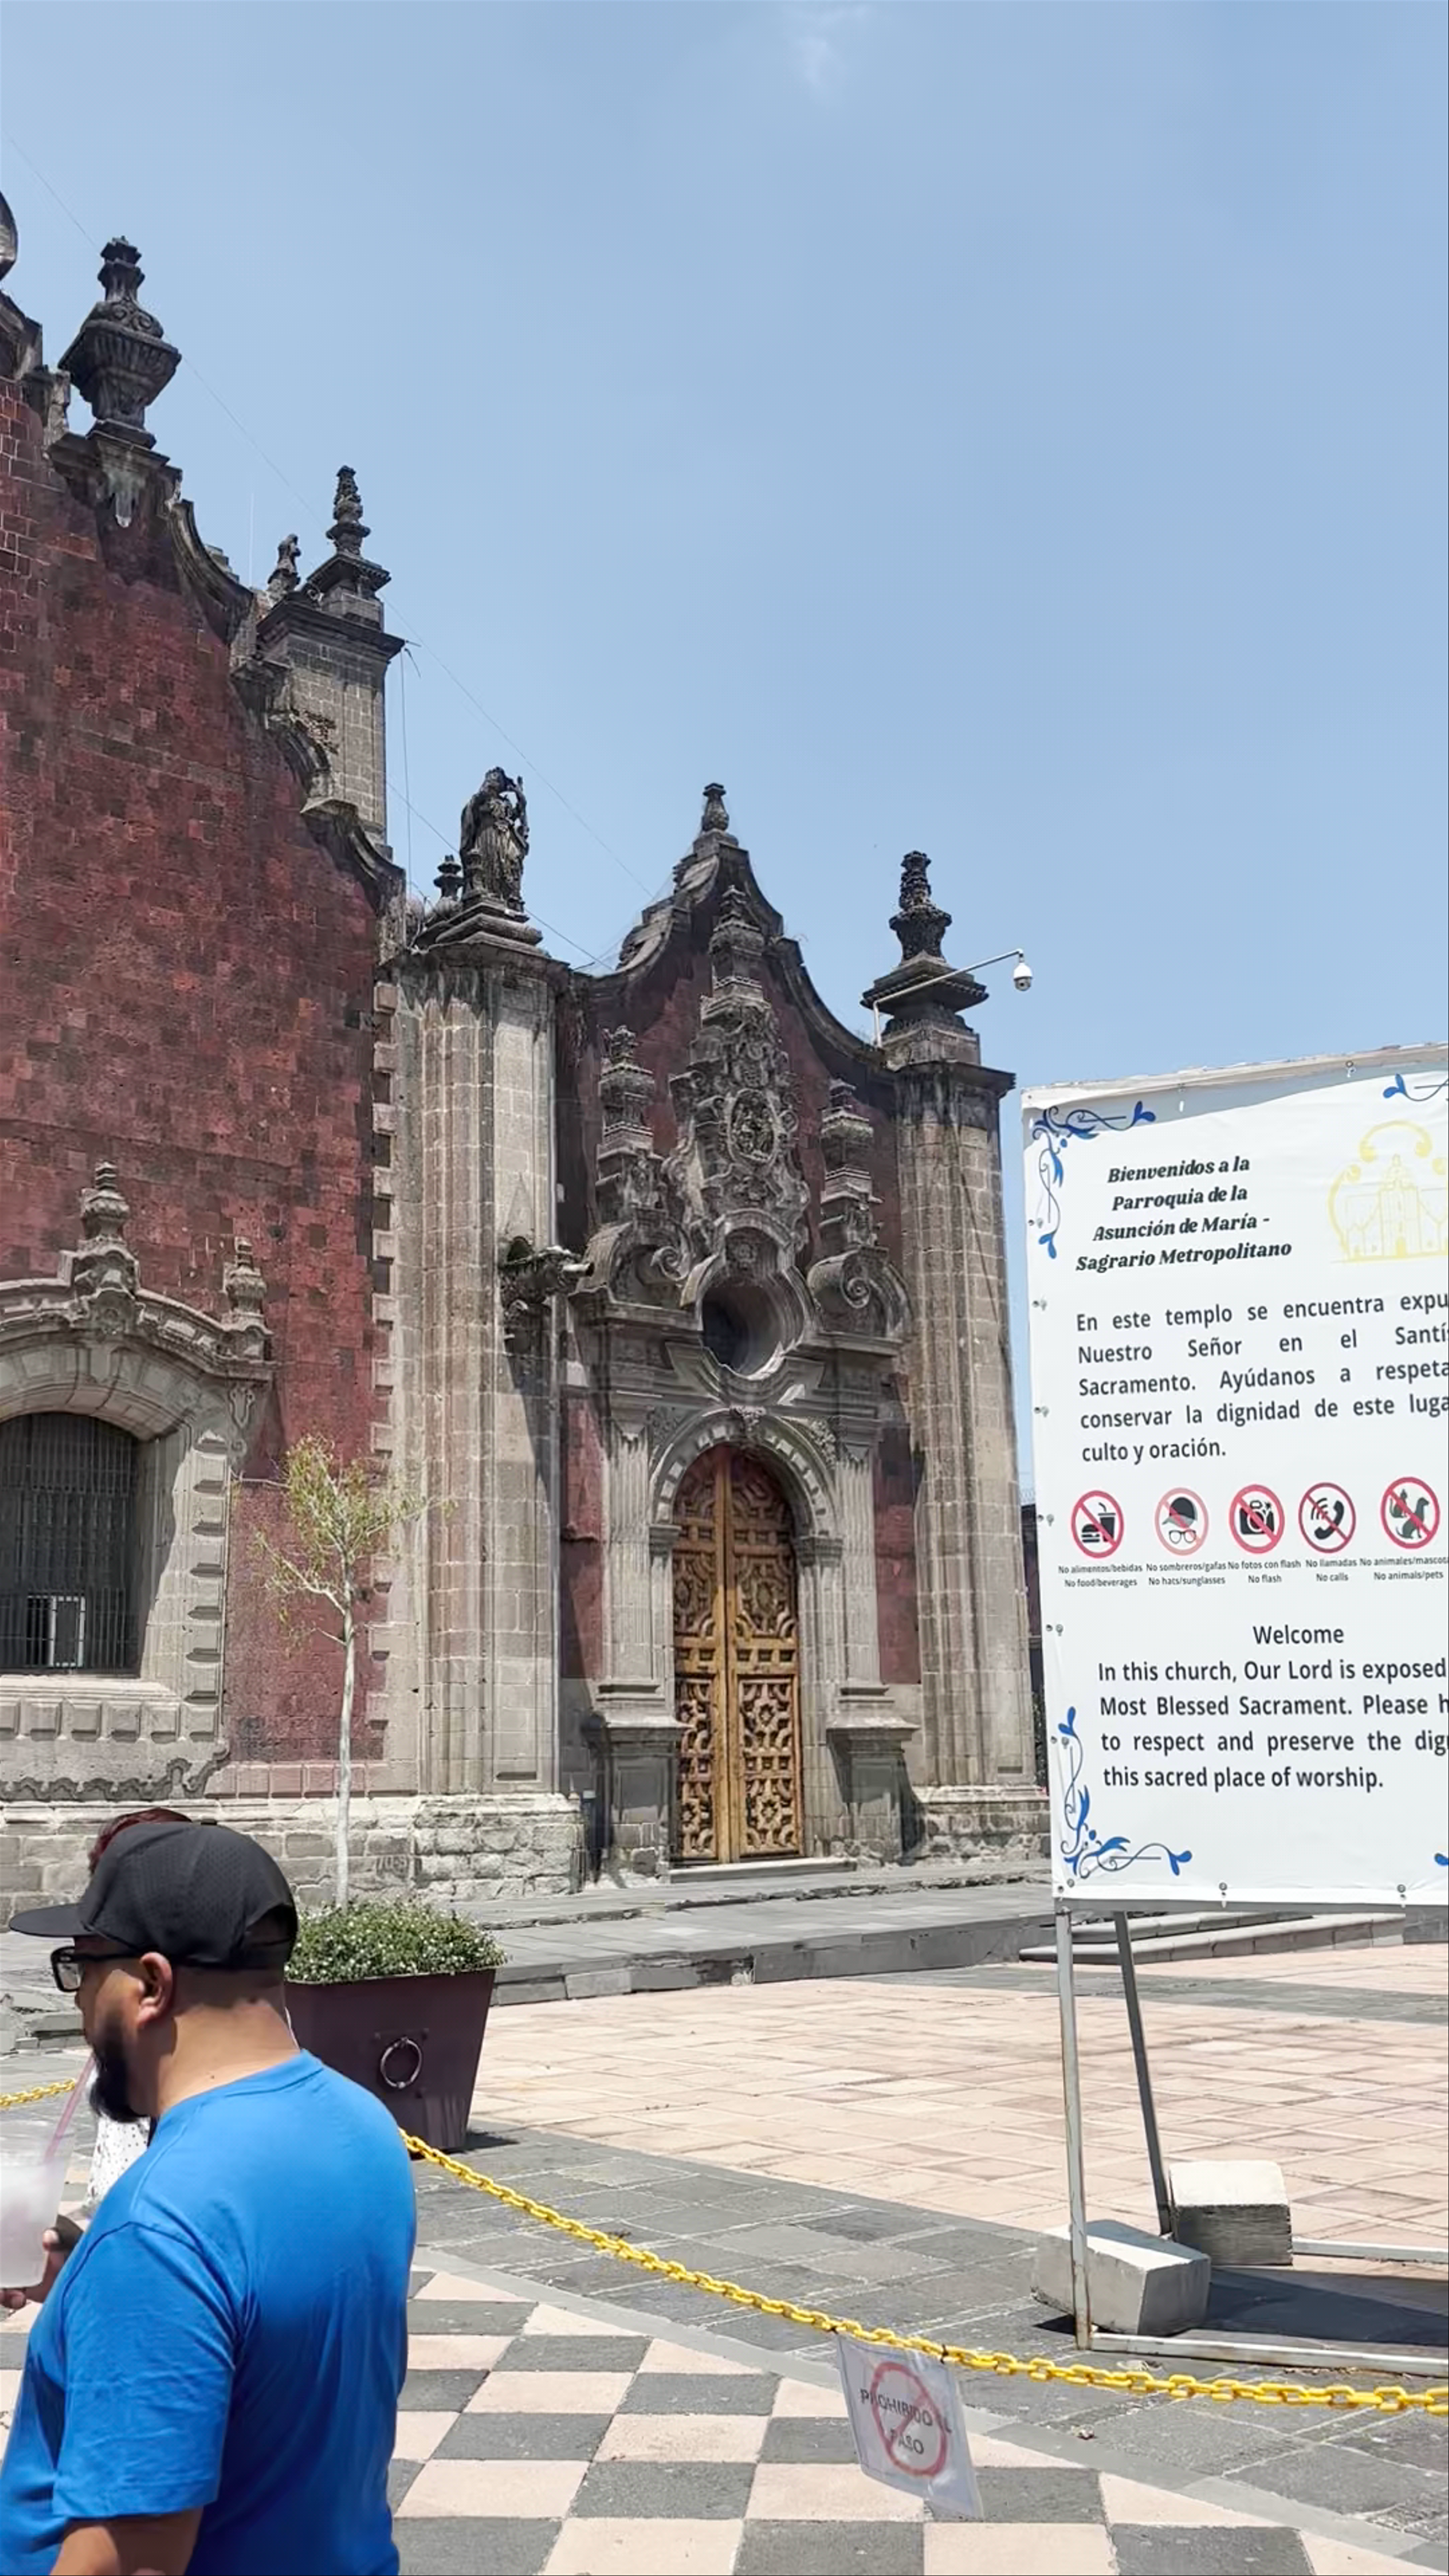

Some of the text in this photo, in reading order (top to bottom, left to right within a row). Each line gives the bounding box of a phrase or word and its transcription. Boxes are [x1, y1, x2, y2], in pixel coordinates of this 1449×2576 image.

[1108, 1155, 1250, 1183] Bienvenidos a la
[1112, 1185, 1247, 1211] Parroquia de la
[1092, 1220, 1175, 1241] Asunción
[1179, 1218, 1198, 1234] de
[1201, 1213, 1257, 1232] María
[1075, 1242, 1292, 1273] Sagrario Metropolitano
[1077, 1314, 1097, 1331] En
[1112, 1312, 1151, 1329] este
[1165, 1304, 1232, 1329] templo
[1247, 1306, 1267, 1321] se
[1283, 1298, 1384, 1319] encuentra
[1078, 1322, 1448, 1364] Nuestro Señor en el Santí
[1079, 1375, 1195, 1396] Sacramento.
[1220, 1367, 1315, 1394] Ayúdanos
[1340, 1368, 1351, 1383] a
[1080, 1410, 1172, 1429] conservar
[1186, 1405, 1202, 1424] la
[1217, 1399, 1300, 1427] dignidad
[1315, 1398, 1338, 1418] de
[1353, 1398, 1394, 1416] este
[1082, 1437, 1226, 1465] culto y oración.
[1071, 1564, 1143, 1574] alimentos/bebidas
[1159, 1561, 1226, 1573] sombreros/gafas
[1227, 1561, 1240, 1570] No
[1241, 1561, 1263, 1570] fotos
[1280, 1559, 1301, 1568] flash
[1319, 1558, 1358, 1567] llamadas
[1077, 1578, 1138, 1589] food/beverages
[1161, 1576, 1226, 1587] hats/sunglasses
[1248, 1574, 1282, 1583] No flash
[1316, 1572, 1349, 1582] No calls
[1374, 1571, 1444, 1581] No animals/pets
[1252, 1624, 1344, 1644] Welcome
[1099, 1657, 1446, 1684] In this church, Our Lord is exposed
[1100, 1697, 1147, 1716] Most
[1157, 1695, 1229, 1716] Blessed
[1239, 1696, 1352, 1715] Sacrament.
[1363, 1694, 1428, 1715] Please
[1101, 1730, 1448, 1757] to respect and preserve the dig
[1103, 1766, 1383, 1793] this sacred place of worship.
[890, 2428, 924, 2455] PASO
